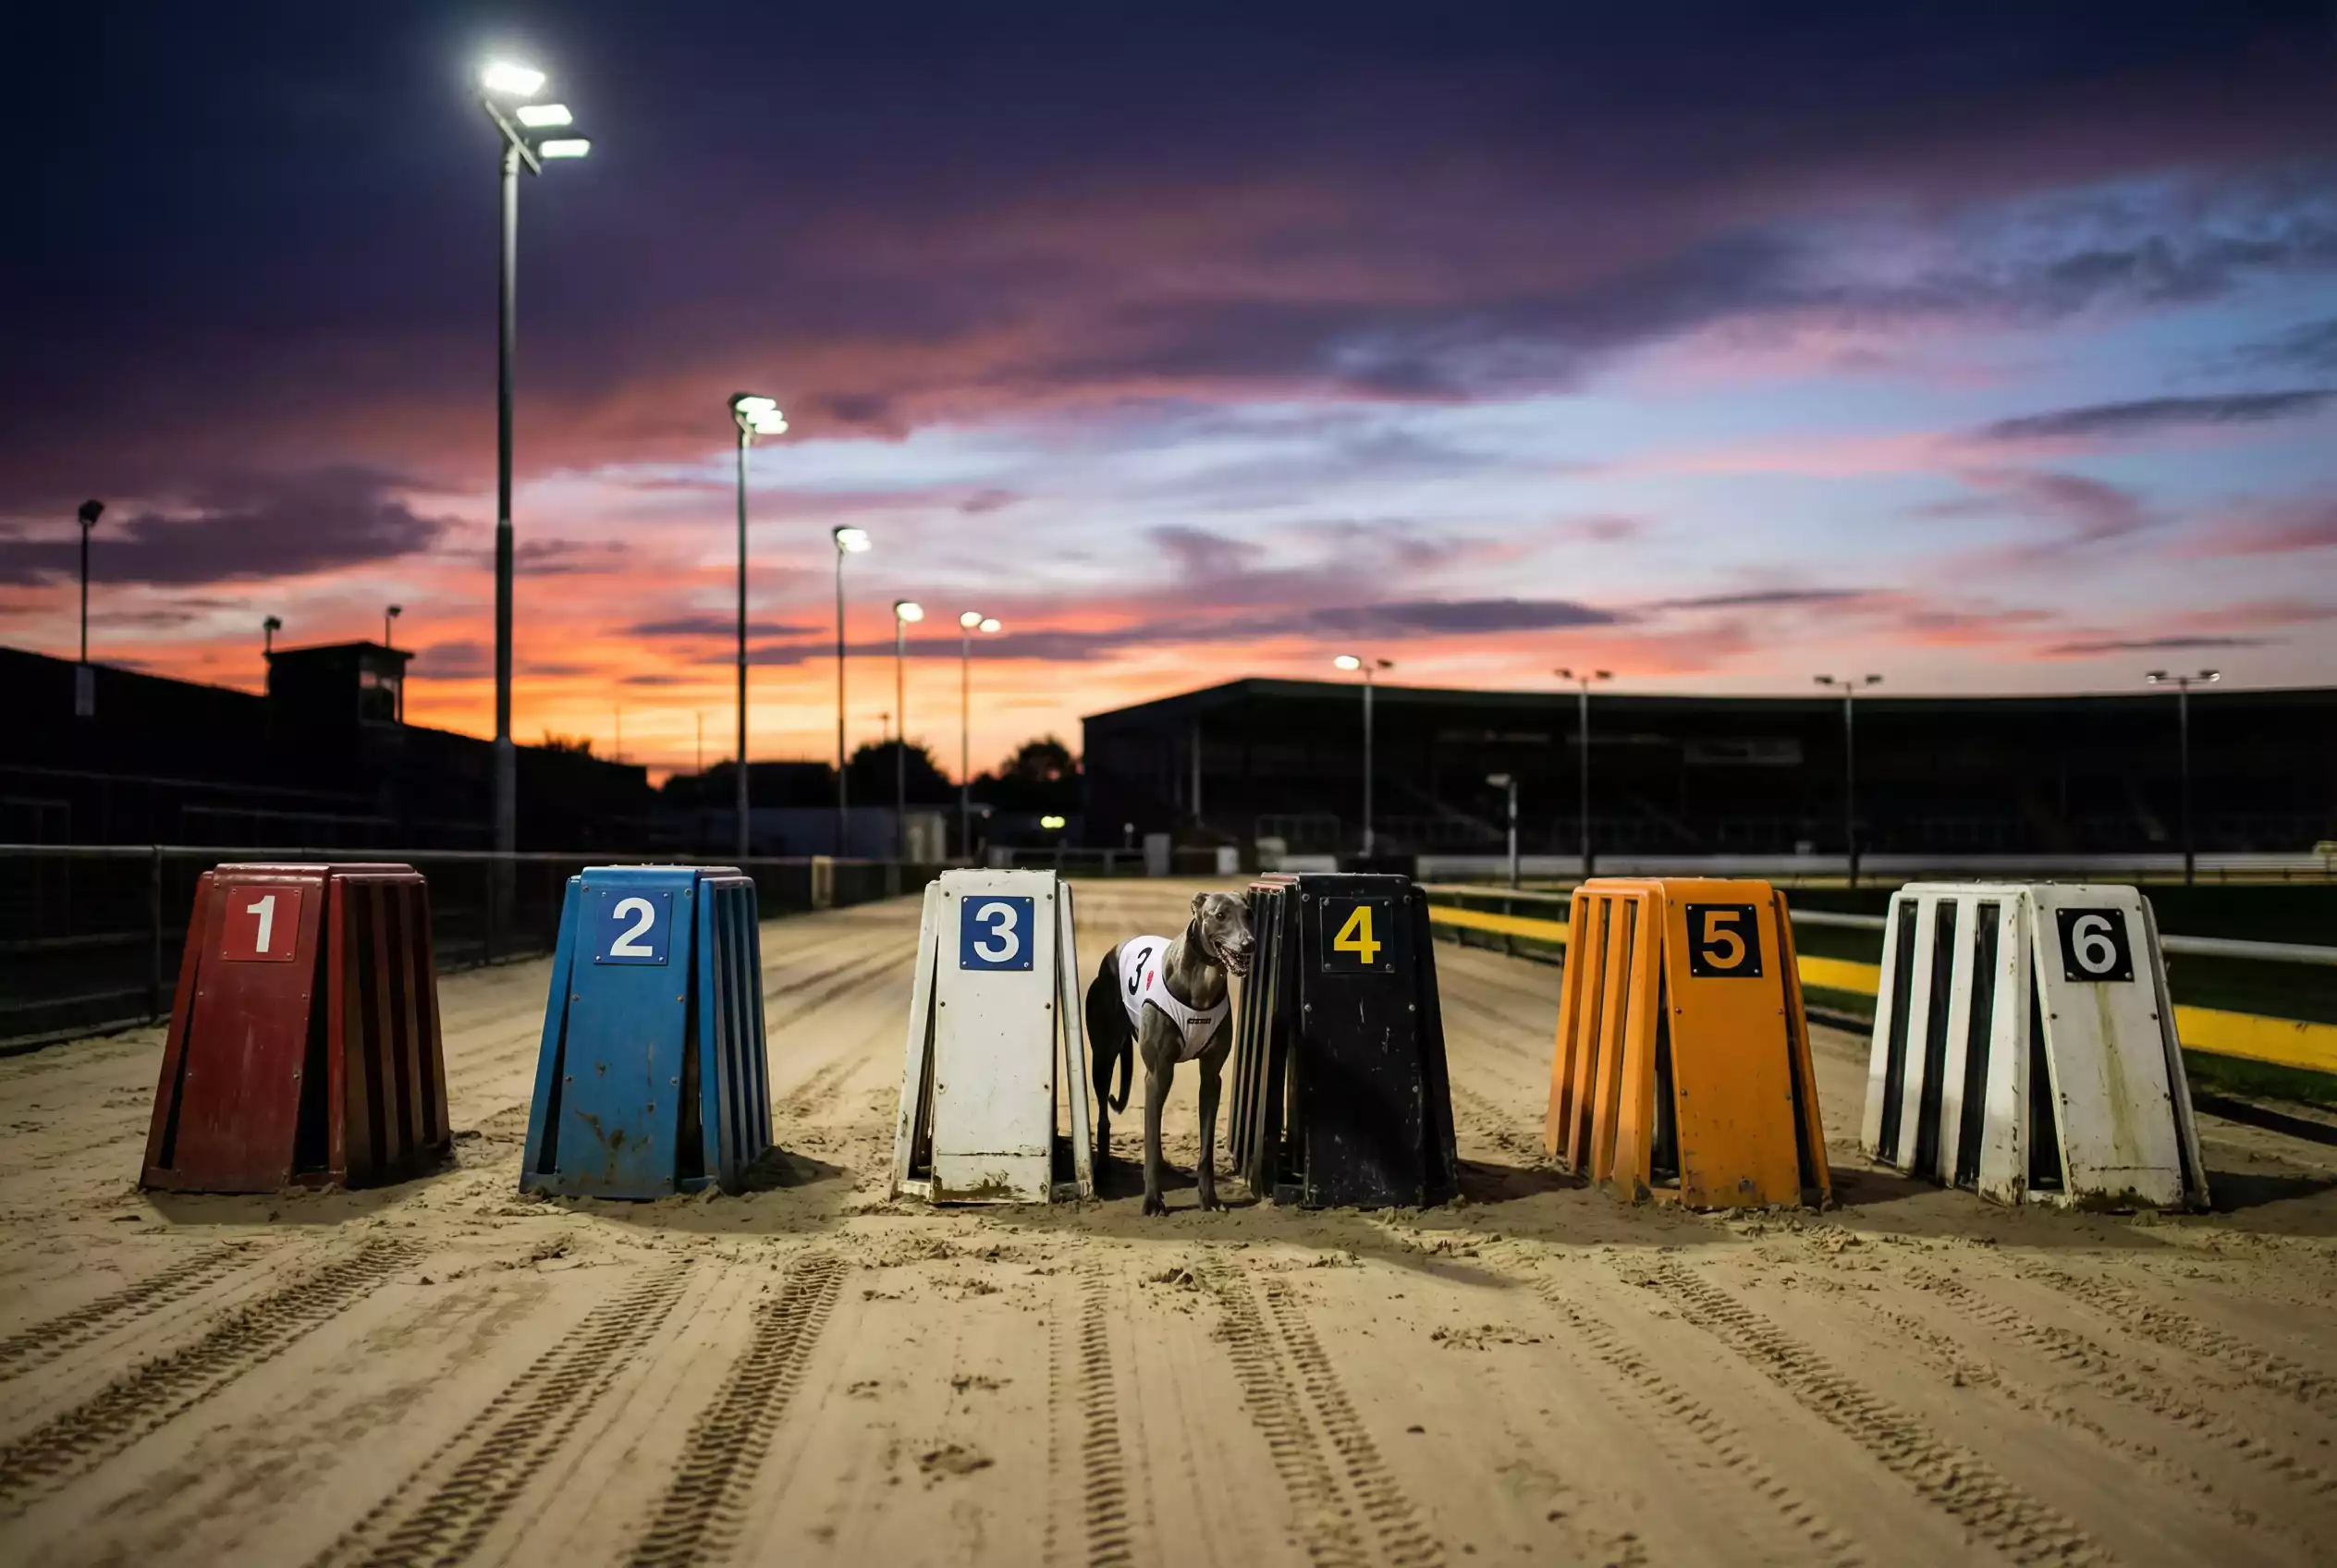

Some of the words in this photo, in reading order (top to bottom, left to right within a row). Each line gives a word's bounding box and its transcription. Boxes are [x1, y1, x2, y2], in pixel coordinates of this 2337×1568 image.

[246, 895, 275, 952] 1
[609, 897, 655, 957] 2
[973, 901, 1020, 963] 3
[1333, 905, 1381, 964] 4
[1702, 911, 1745, 969] 5
[2072, 914, 2117, 974] 6
[1128, 947, 1153, 996] 3
